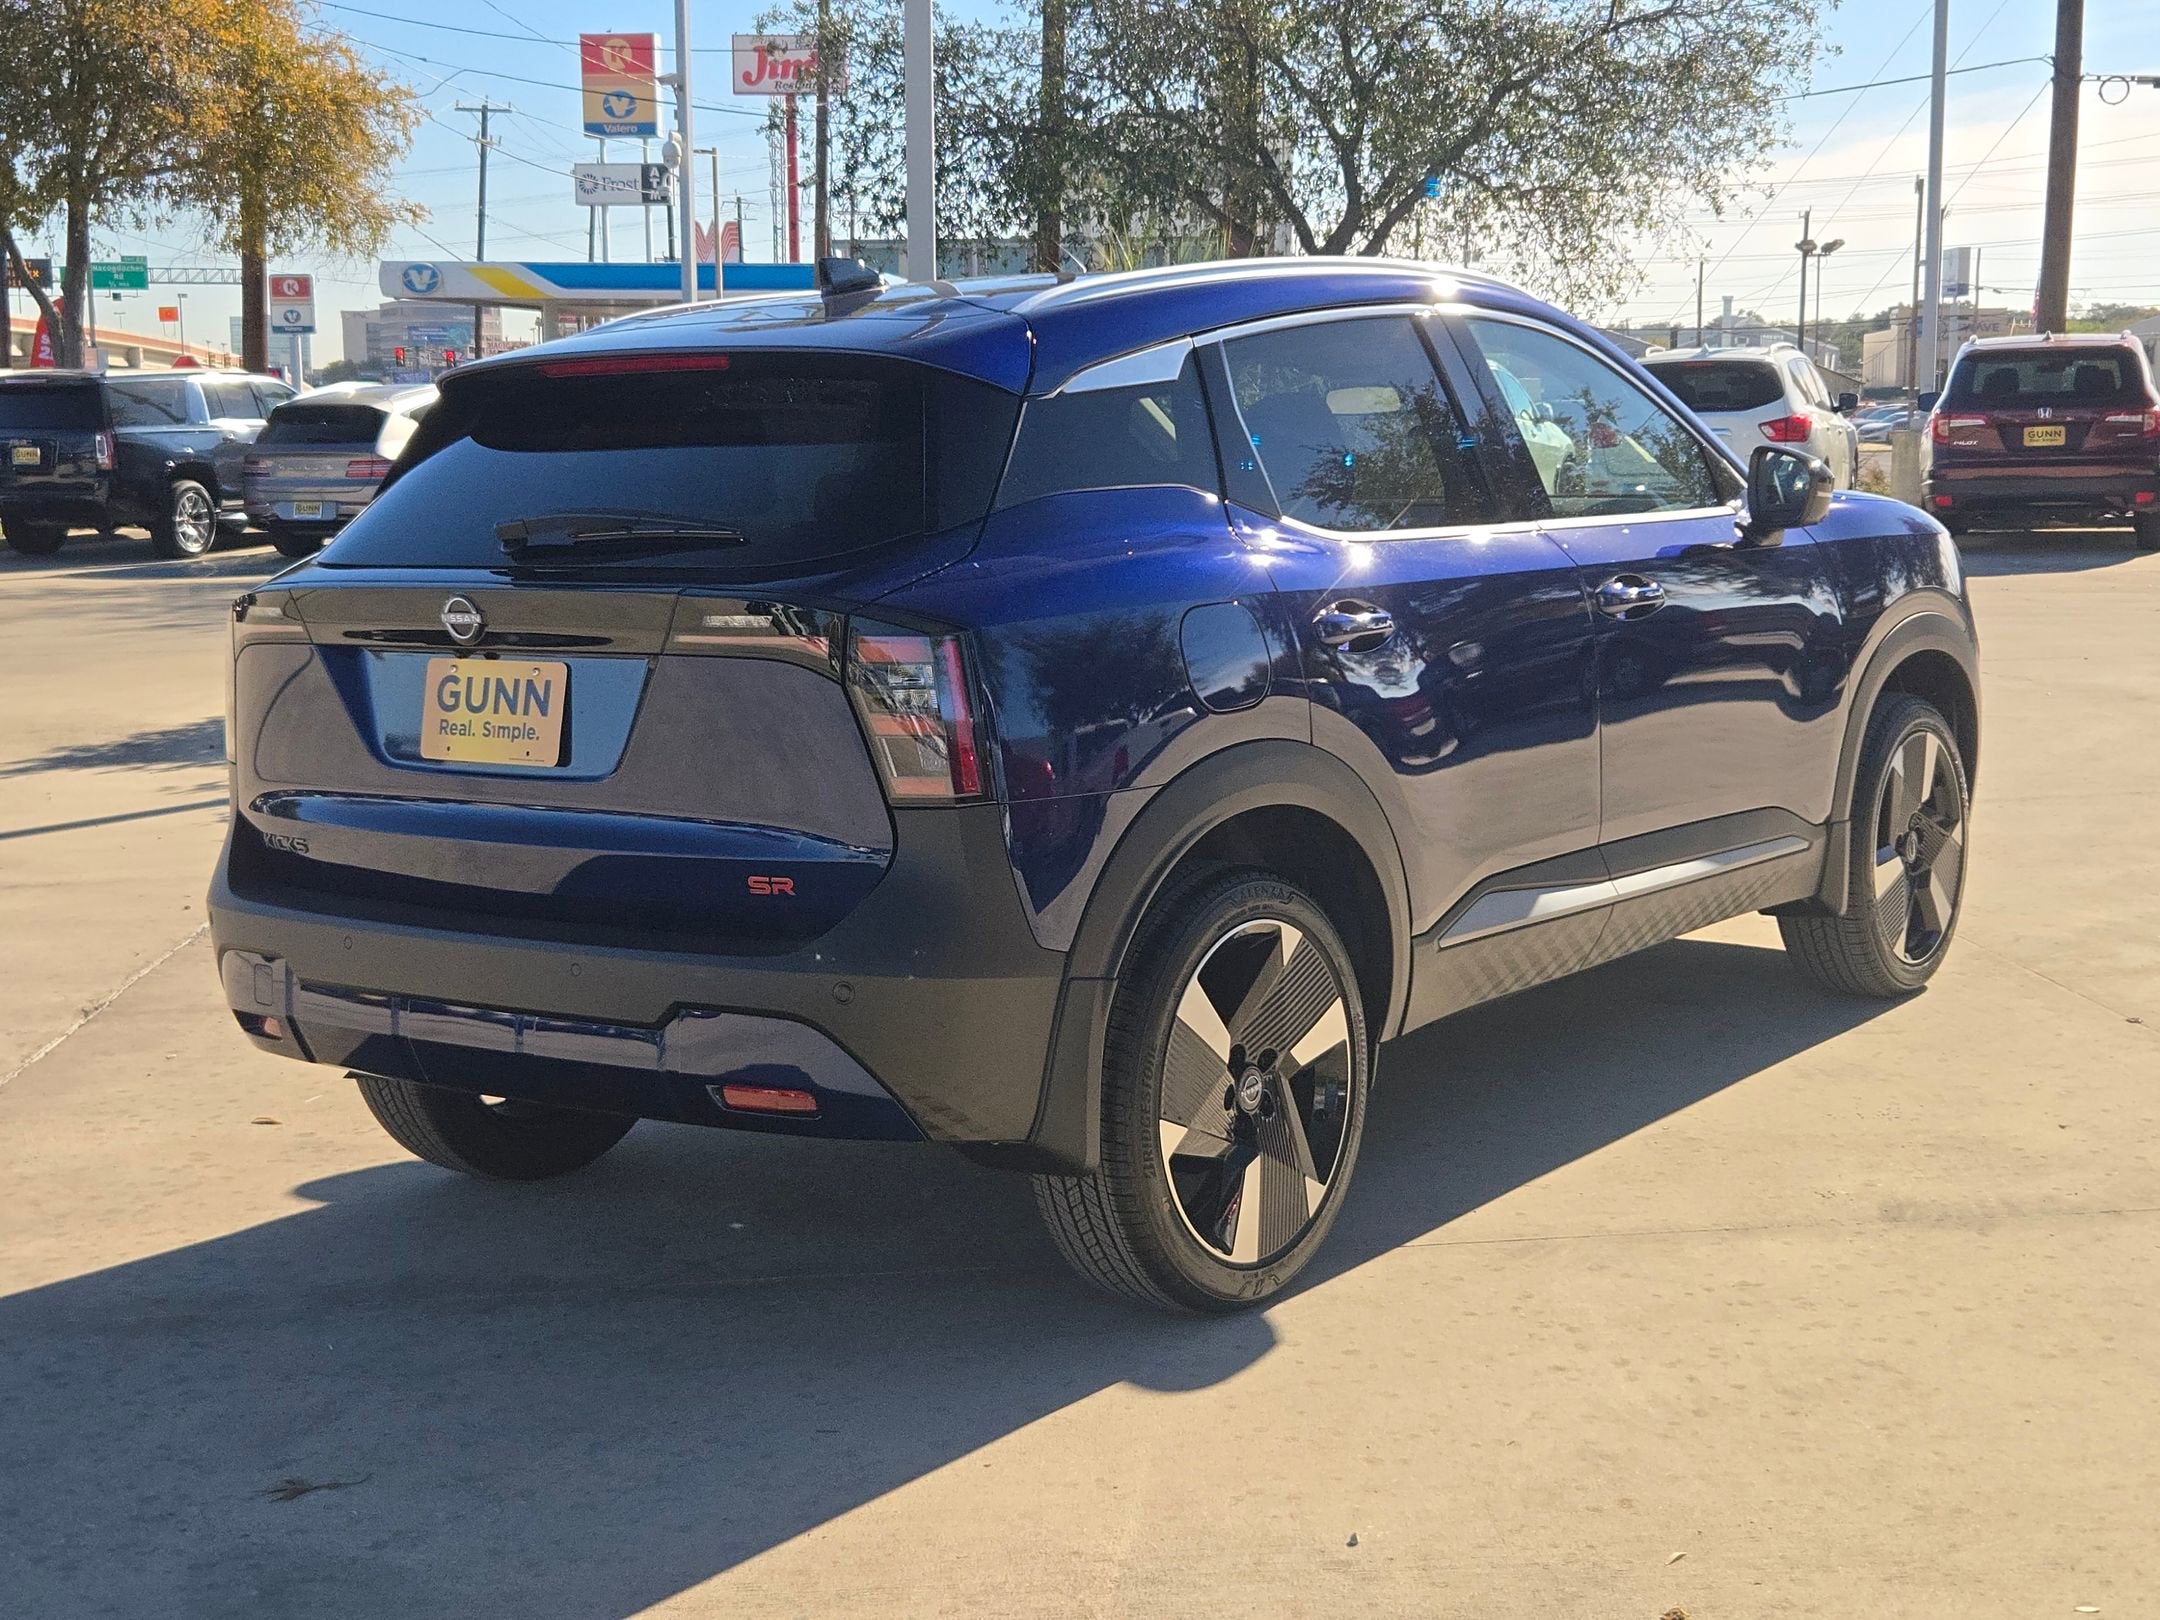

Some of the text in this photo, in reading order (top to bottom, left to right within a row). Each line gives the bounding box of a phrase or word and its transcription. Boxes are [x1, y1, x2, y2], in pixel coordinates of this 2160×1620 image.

[603, 124, 638, 133] Valero
[602, 177, 640, 191] Frost
[2028, 430, 2062, 439] GUNN
[441, 612, 482, 624] NISSAN
[437, 674, 552, 718] GUNN
[439, 719, 476, 737] Real.
[747, 875, 796, 896] SR
